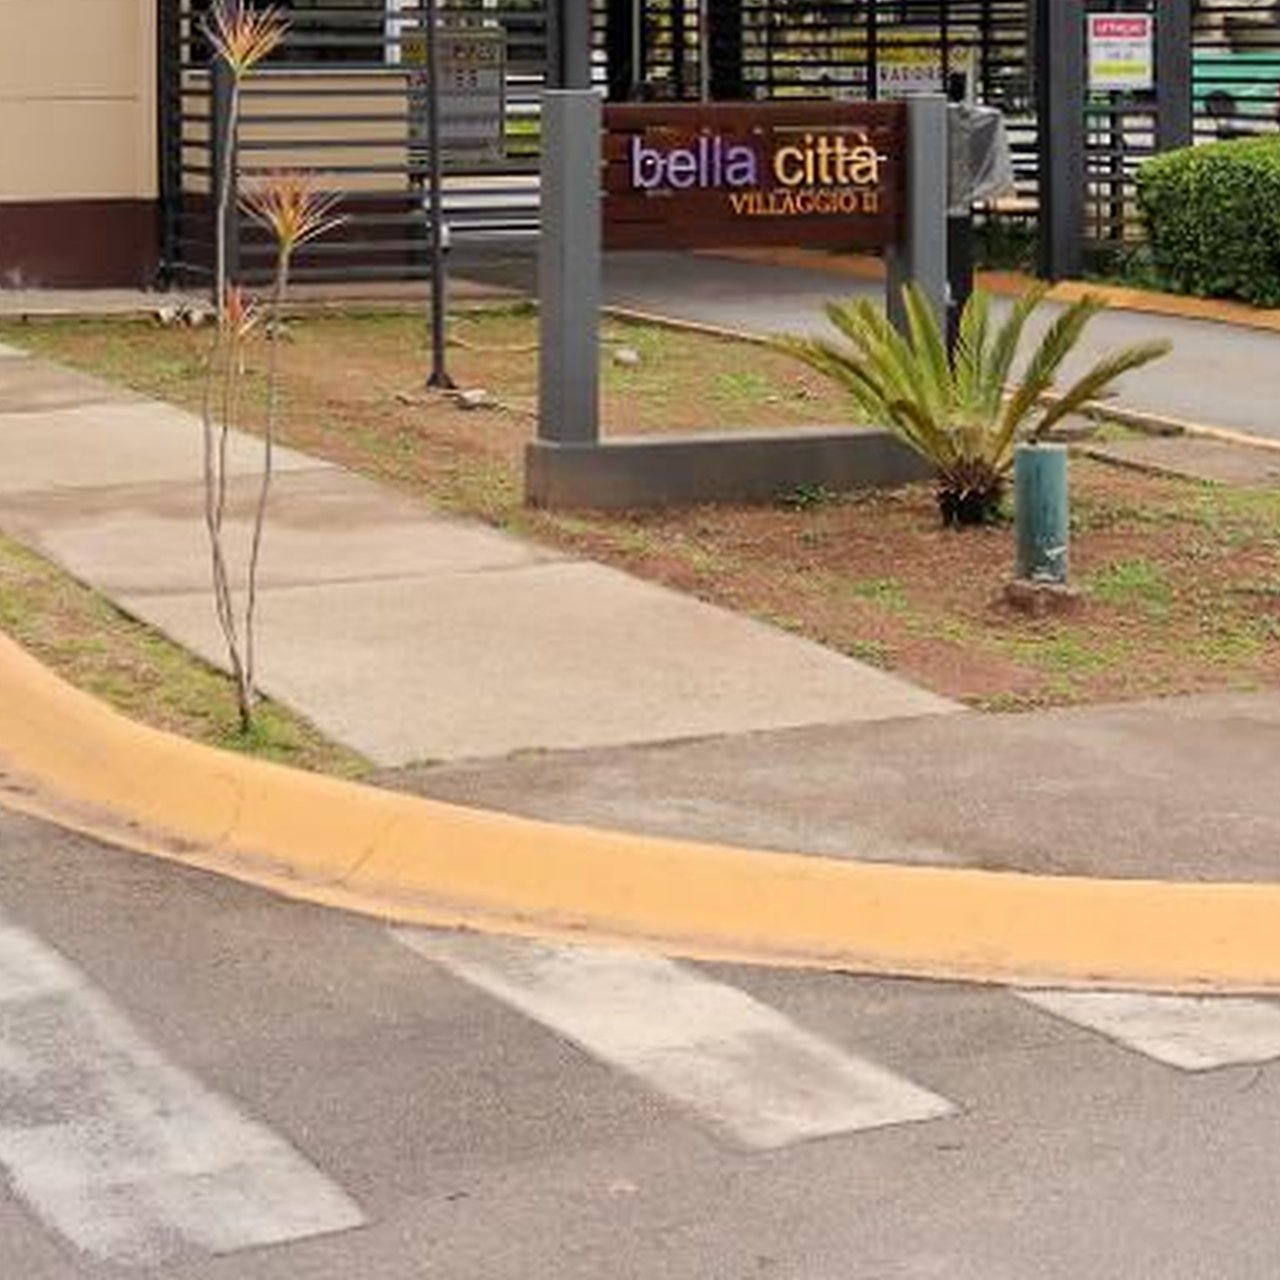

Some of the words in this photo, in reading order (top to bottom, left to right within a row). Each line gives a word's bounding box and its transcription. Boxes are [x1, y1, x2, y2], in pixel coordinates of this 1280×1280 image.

[632, 135, 756, 188] bella
[773, 132, 879, 186] città
[731, 190, 856, 214] VILLAGGIO
